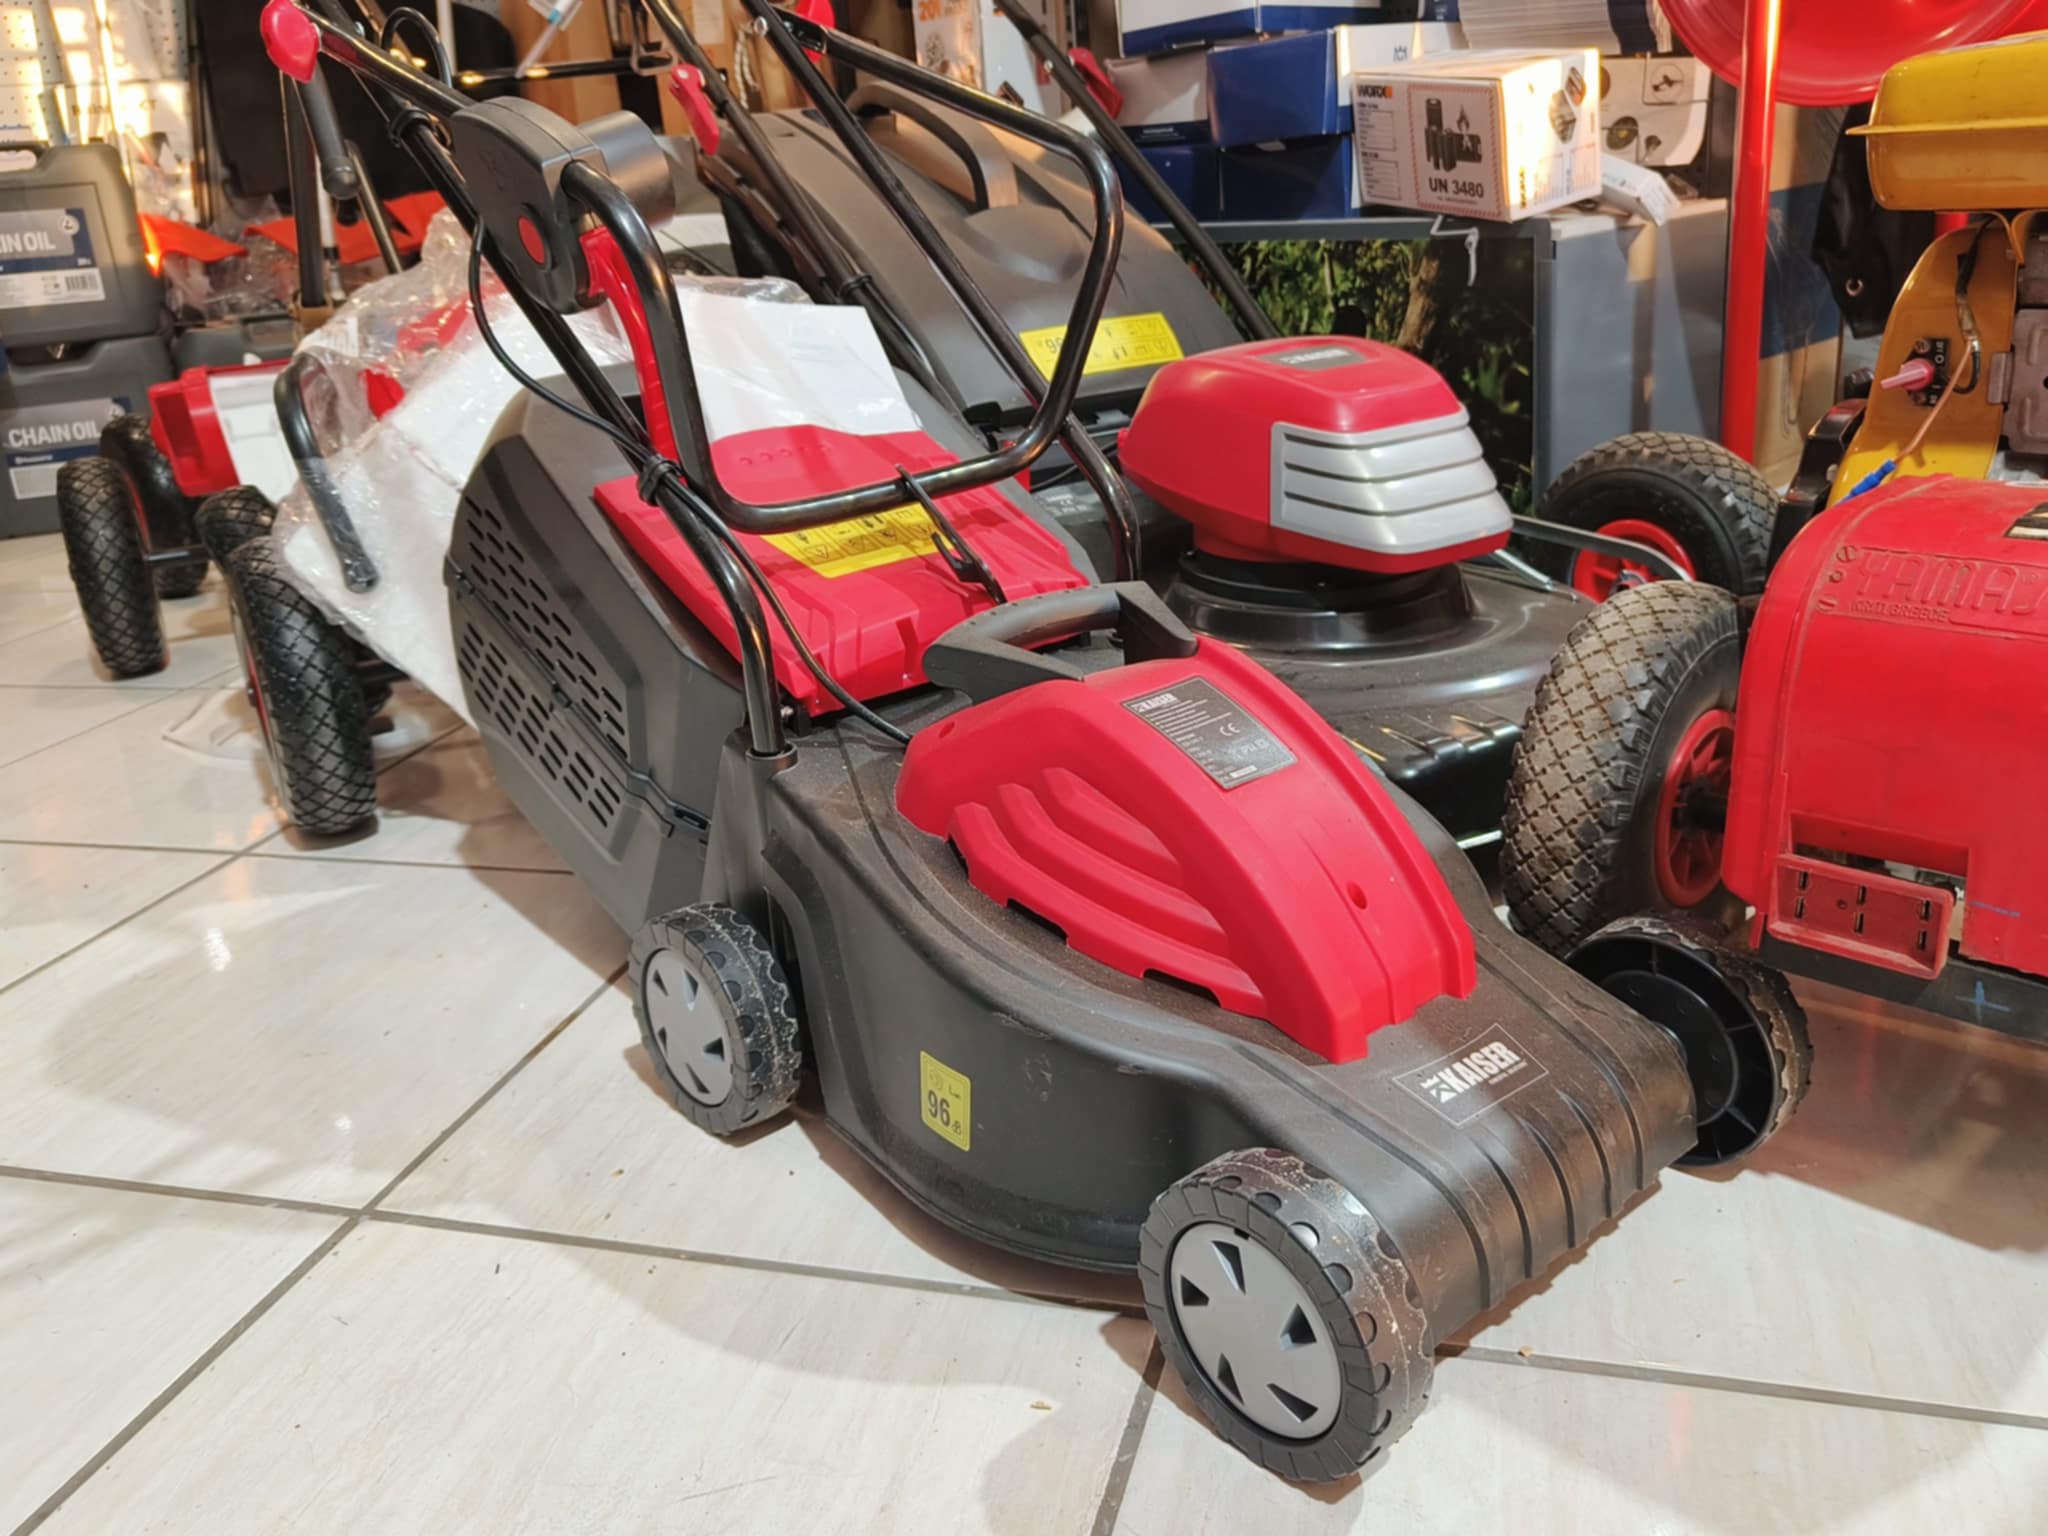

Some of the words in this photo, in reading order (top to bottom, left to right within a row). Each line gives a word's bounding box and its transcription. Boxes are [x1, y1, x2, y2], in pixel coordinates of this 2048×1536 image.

[1428, 177, 1448, 193] UN
[1452, 179, 1484, 198] 3480
[0, 233, 22, 253] IN
[23, 231, 56, 252] OIL
[8, 424, 71, 448] CHAIN
[72, 420, 102, 441] OIL
[1437, 1041, 1521, 1094] KAISER
[928, 1089, 950, 1127] 96
